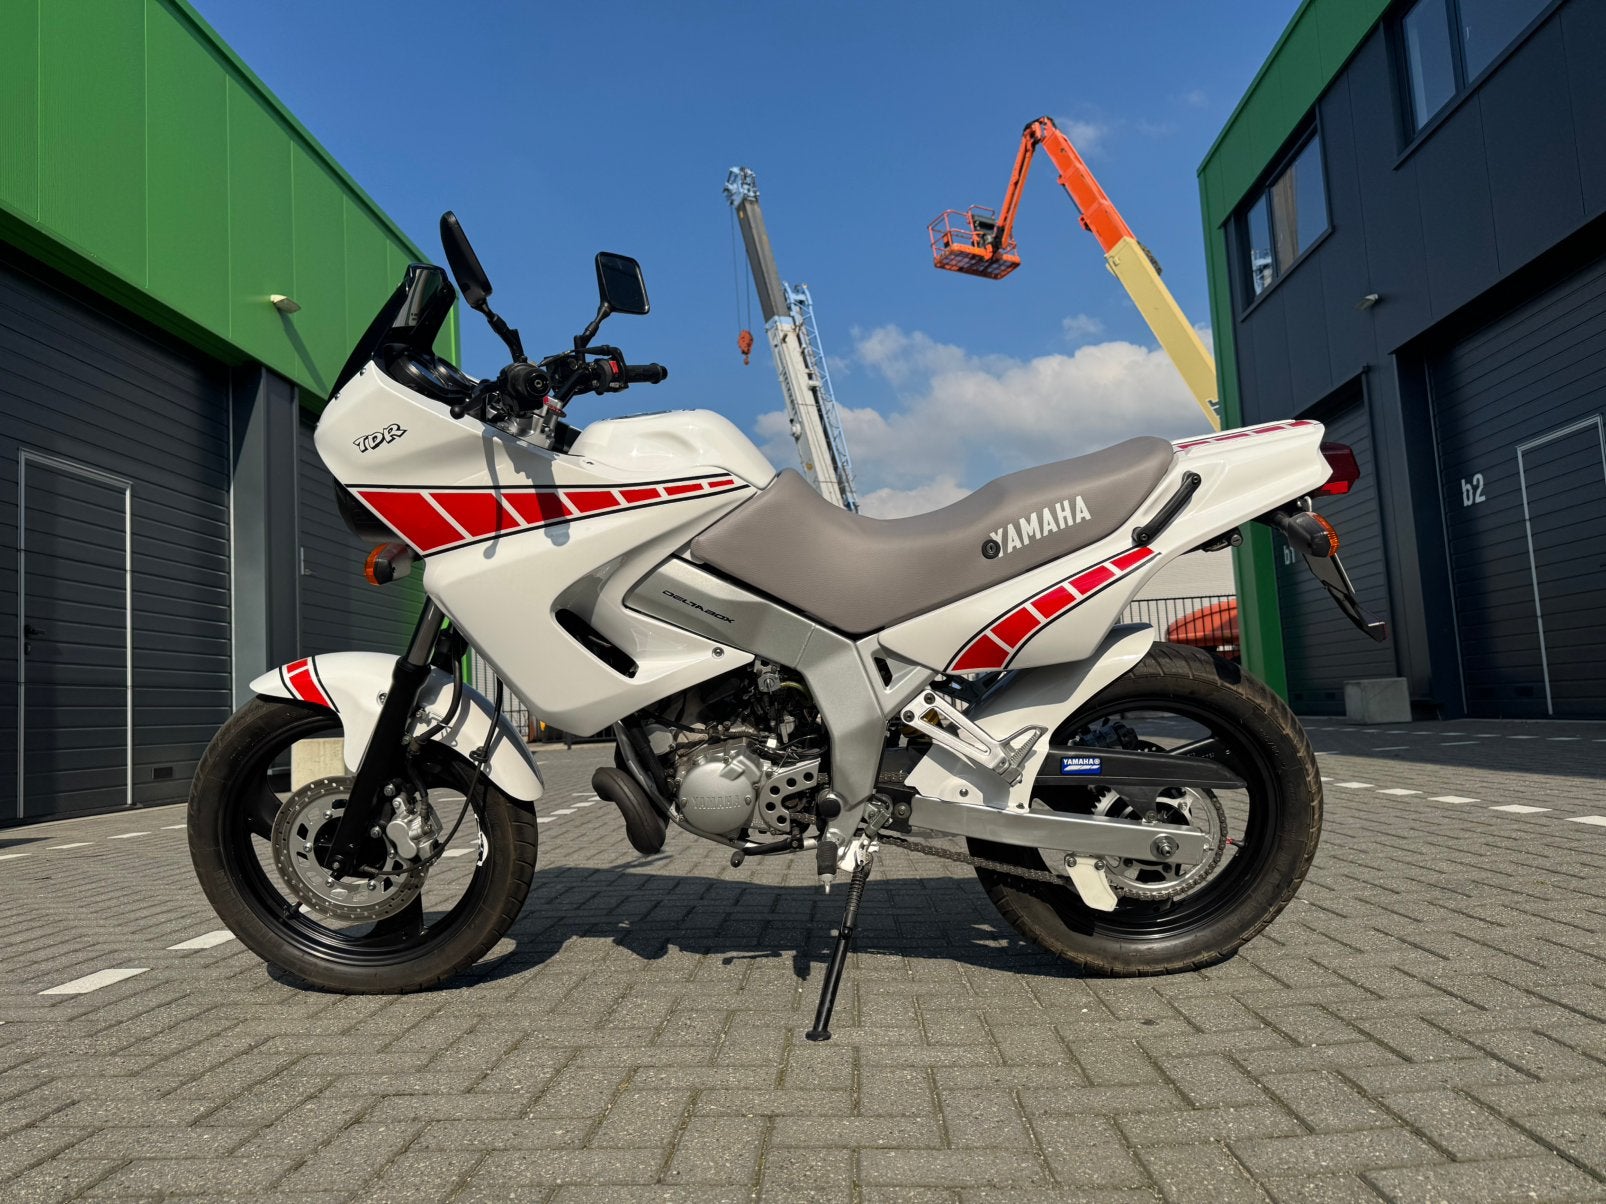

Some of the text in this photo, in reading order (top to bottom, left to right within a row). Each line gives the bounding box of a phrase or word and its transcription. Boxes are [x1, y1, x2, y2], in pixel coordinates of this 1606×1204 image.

[352, 423, 408, 453] TDR
[1461, 473, 1486, 507] b2
[989, 495, 1092, 558] YAMAHA
[662, 590, 735, 623] DELTABOX
